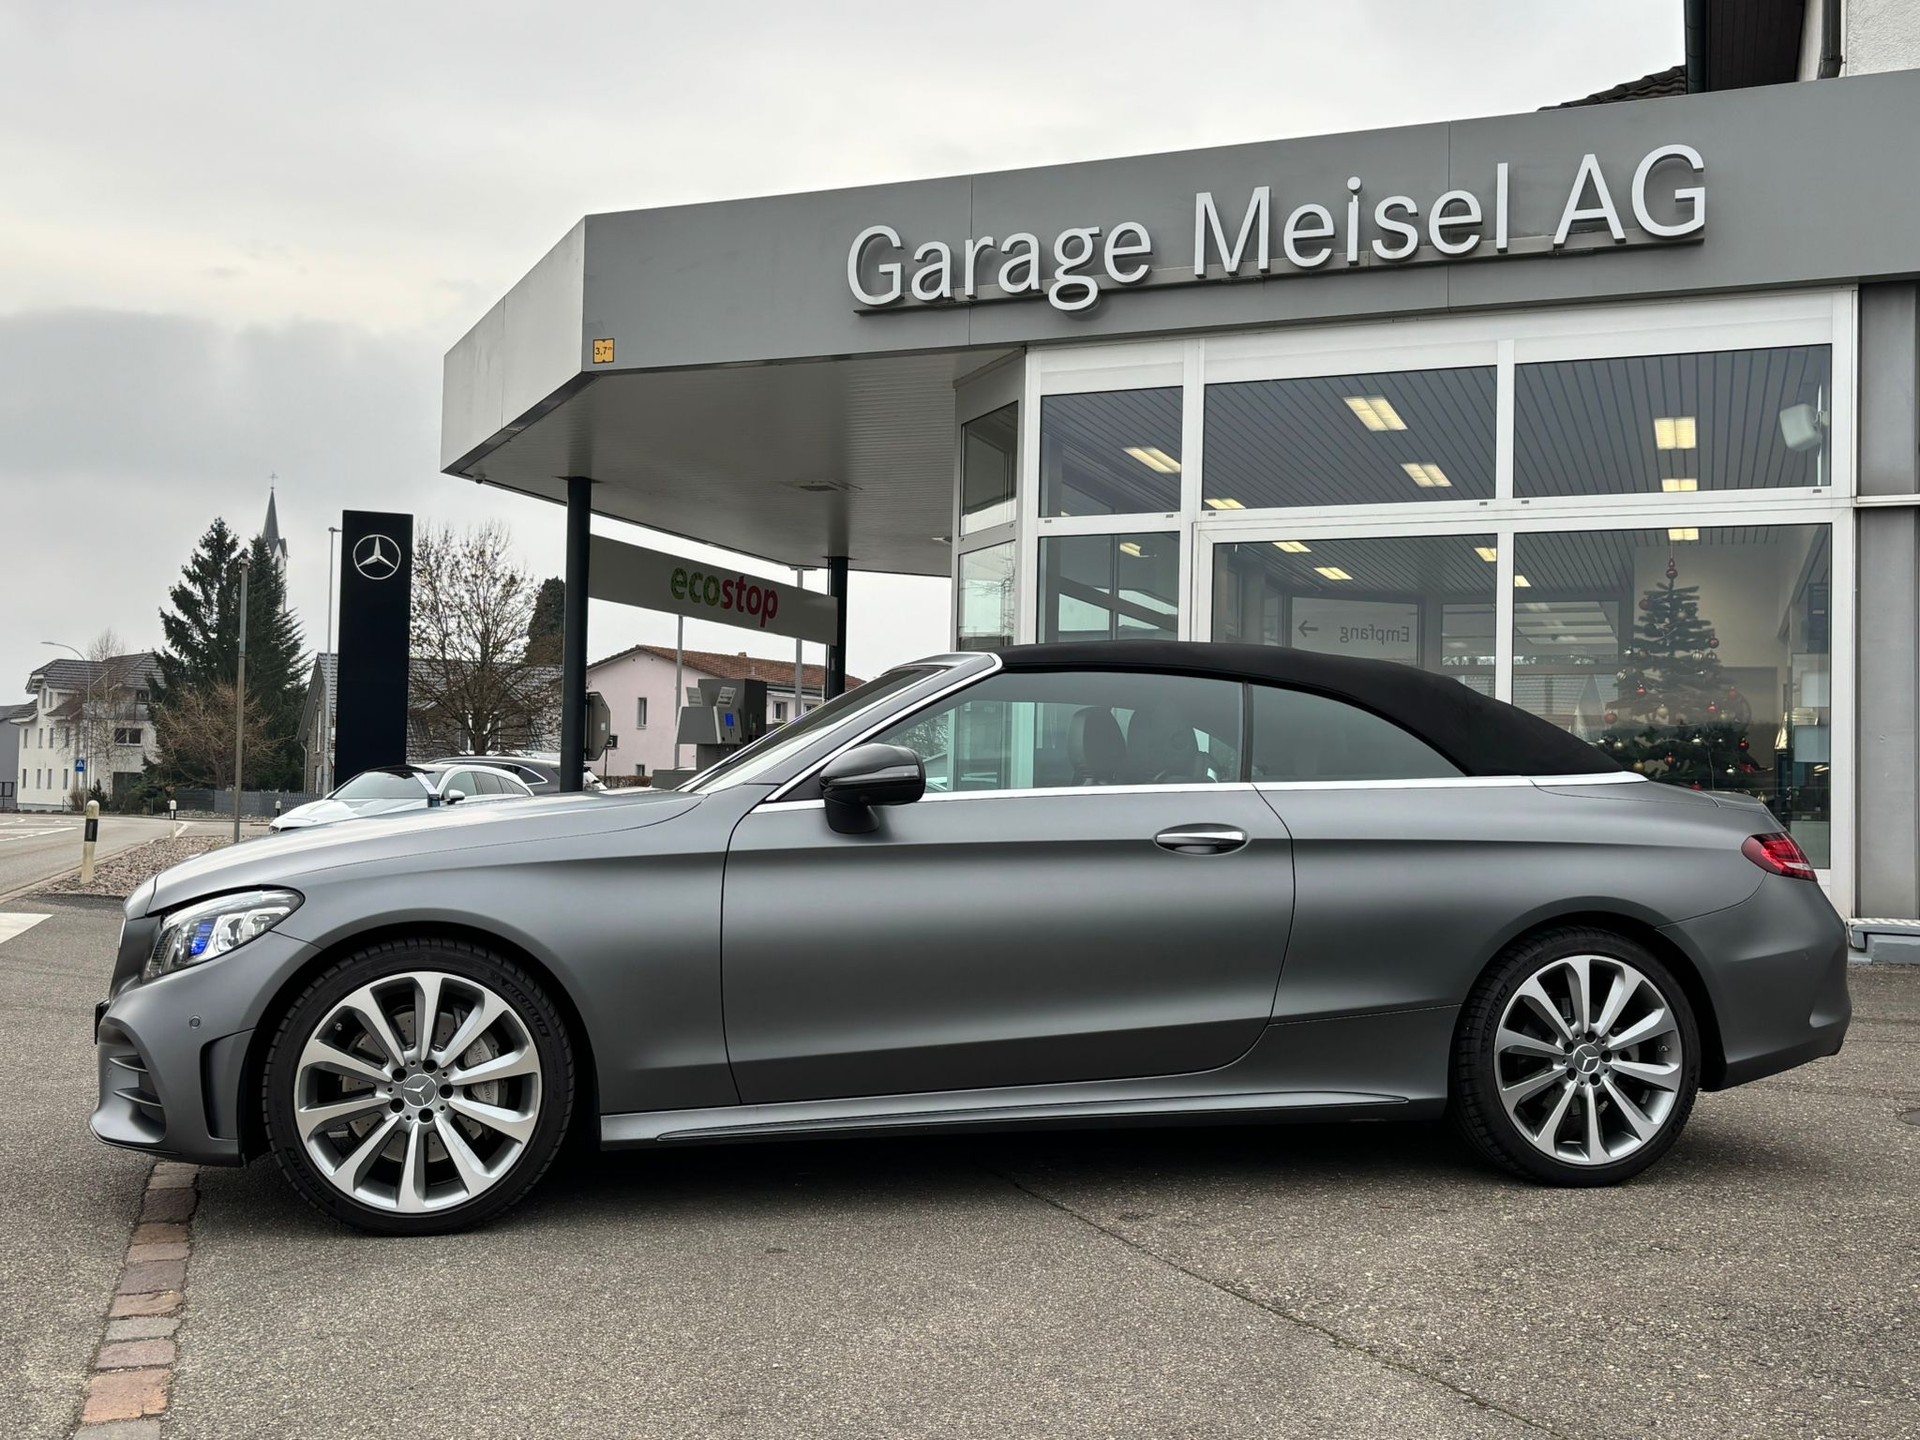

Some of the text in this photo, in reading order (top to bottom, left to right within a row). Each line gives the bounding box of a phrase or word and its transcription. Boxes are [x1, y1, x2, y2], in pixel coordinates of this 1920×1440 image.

[847, 143, 1706, 312] Garage Meisel AG
[670, 567, 779, 628] ecostop
[503, 980, 551, 1037] MICHELIN
